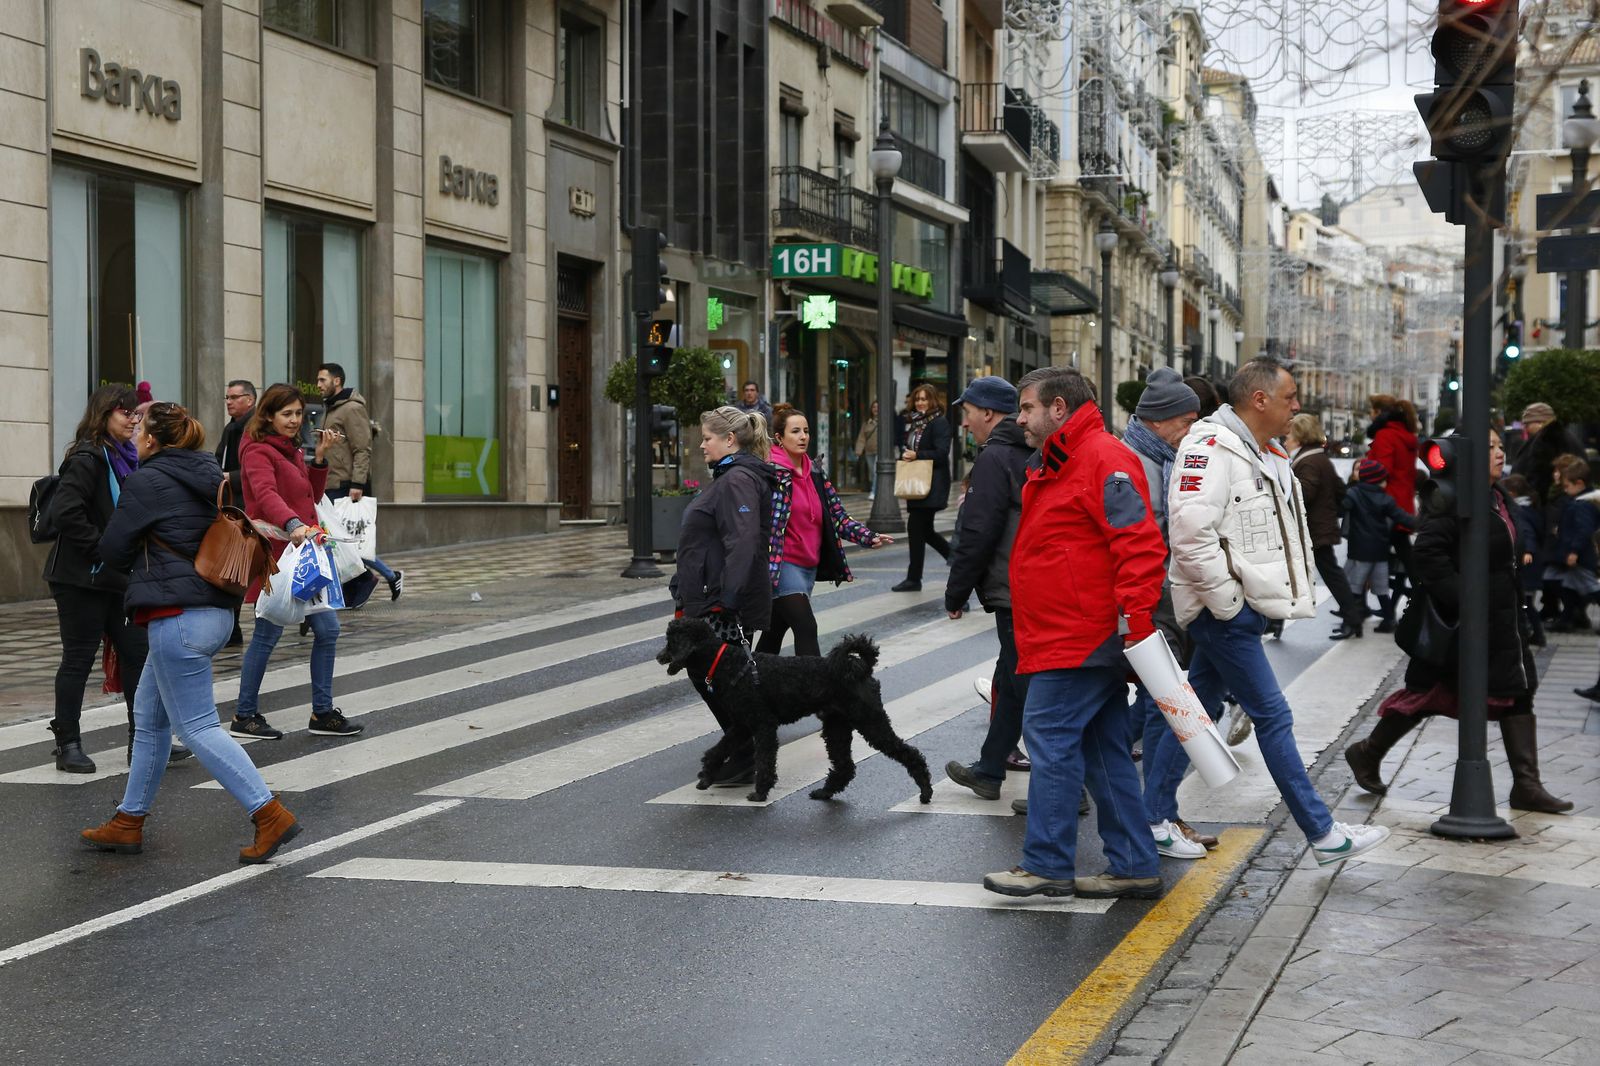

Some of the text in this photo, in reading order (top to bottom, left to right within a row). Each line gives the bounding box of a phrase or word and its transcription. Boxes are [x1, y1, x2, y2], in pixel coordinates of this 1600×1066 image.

[80, 48, 181, 121] Bankia
[439, 155, 499, 207] Bankia
[777, 248, 832, 274] 16H
[841, 247, 934, 299] FARACIA
[1239, 507, 1279, 553] H
